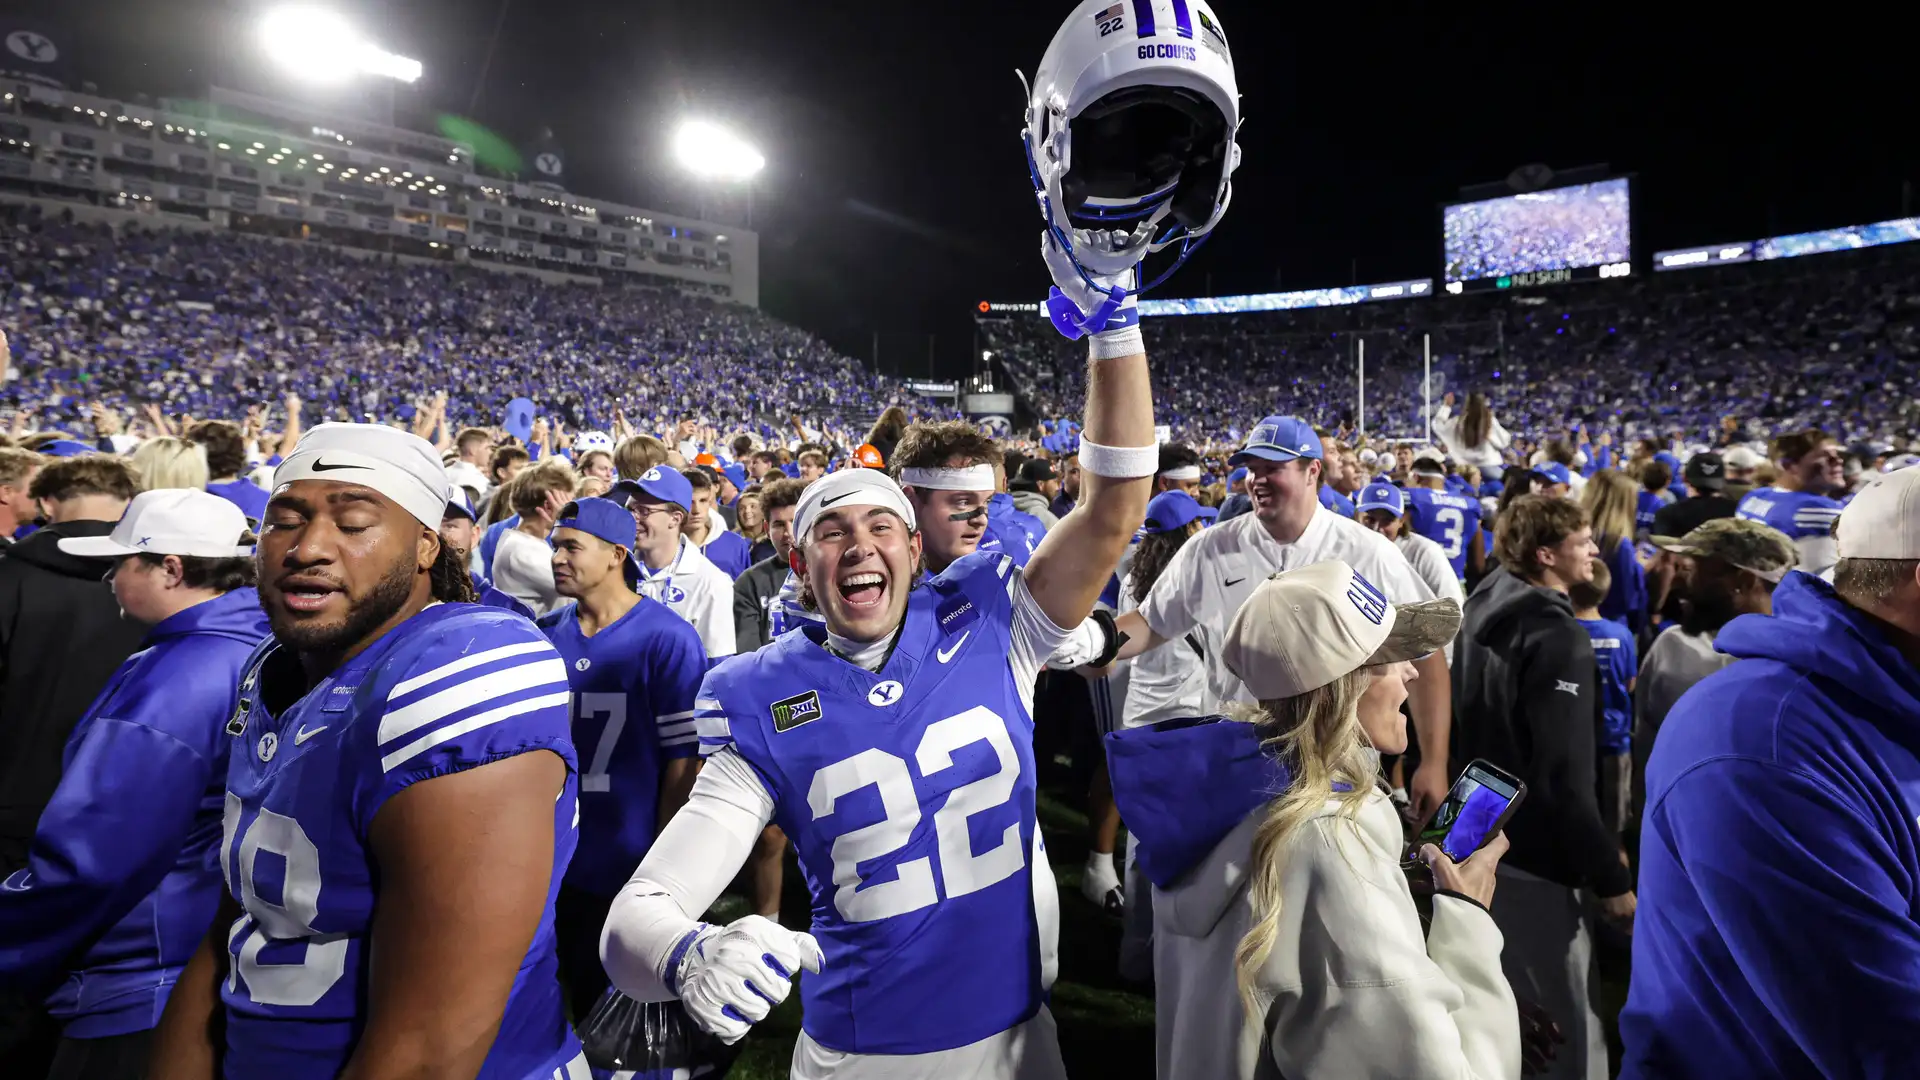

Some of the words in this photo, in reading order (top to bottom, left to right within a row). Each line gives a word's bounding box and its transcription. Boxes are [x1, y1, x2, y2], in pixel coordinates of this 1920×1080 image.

[1100, 17, 1124, 37] 22
[1138, 45, 1155, 59] GO
[1156, 44, 1196, 61] COUGS
[1436, 508, 1464, 558] 3
[942, 602, 973, 624] entrata
[568, 692, 627, 792] 7
[807, 705, 1025, 922] 22
